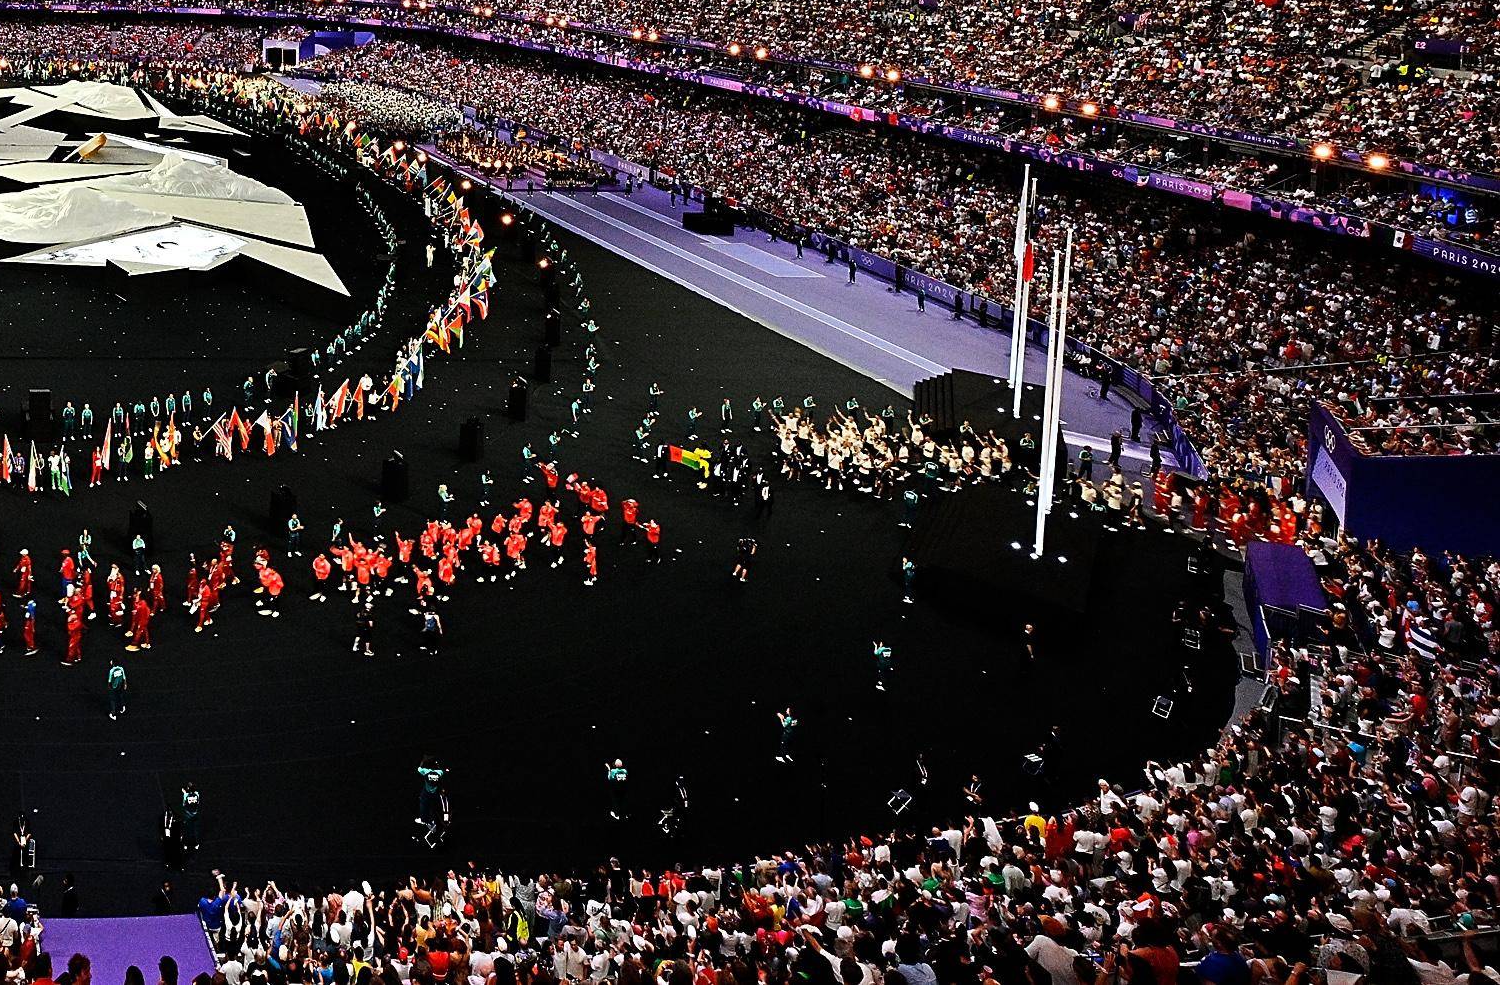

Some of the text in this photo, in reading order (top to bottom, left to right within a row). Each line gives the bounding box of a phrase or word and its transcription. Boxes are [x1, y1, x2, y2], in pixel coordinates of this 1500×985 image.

[963, 133, 984, 144] PARIS
[1243, 134, 1261, 142] PARIS
[1112, 169, 1124, 178] C6
[1155, 178, 1184, 191] PARIS
[1347, 225, 1361, 237] C5
[1433, 247, 1500, 274] PARIS 202
